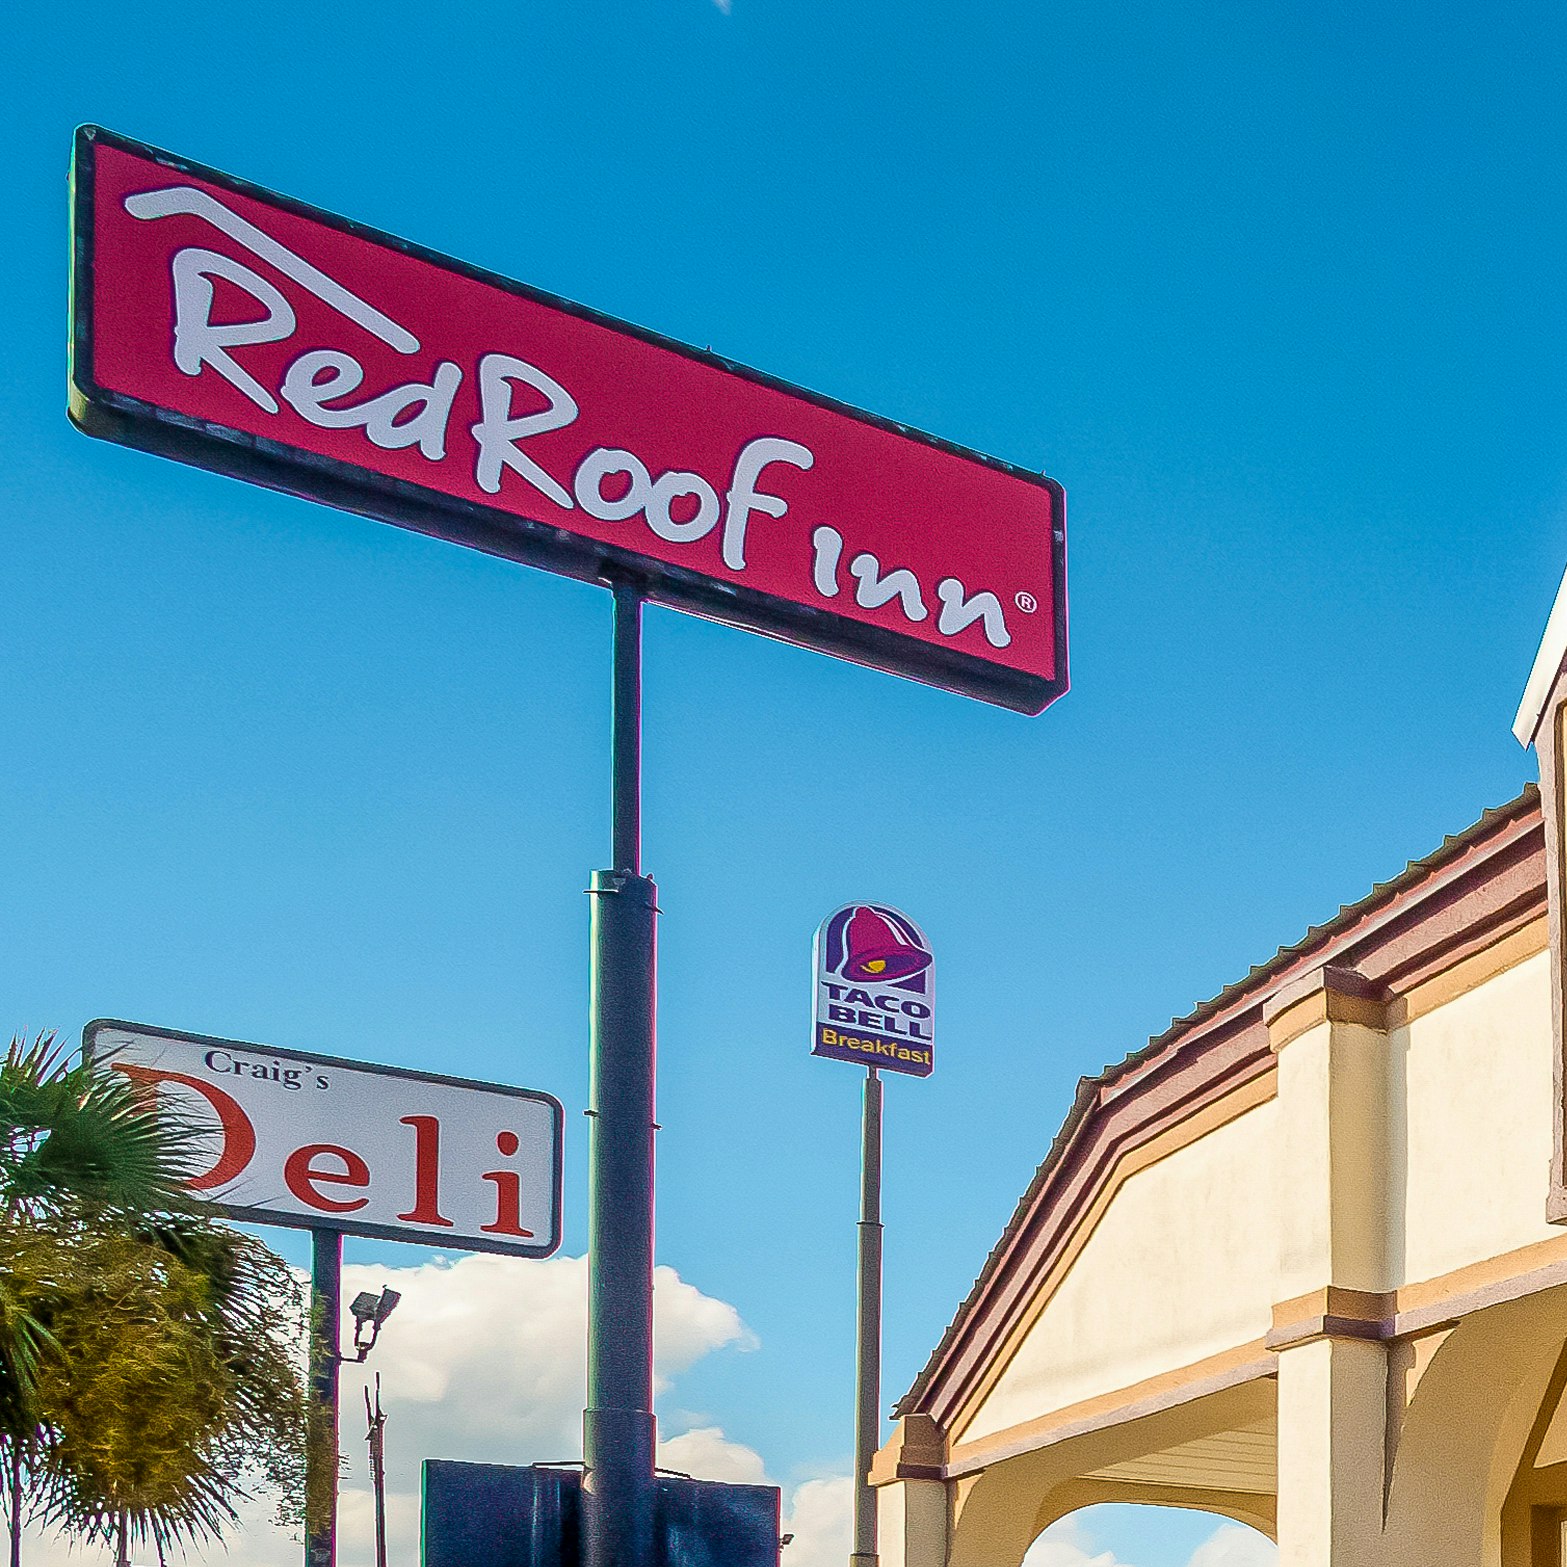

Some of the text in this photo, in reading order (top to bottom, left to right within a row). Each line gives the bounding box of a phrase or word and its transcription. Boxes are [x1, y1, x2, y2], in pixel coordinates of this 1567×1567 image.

[821, 981, 931, 1019] TACO
[828, 1003, 932, 1040] BELL
[822, 1028, 931, 1065] Breakfast
[204, 1050, 329, 1091] Craig's
[111, 1062, 534, 1238] Deli
